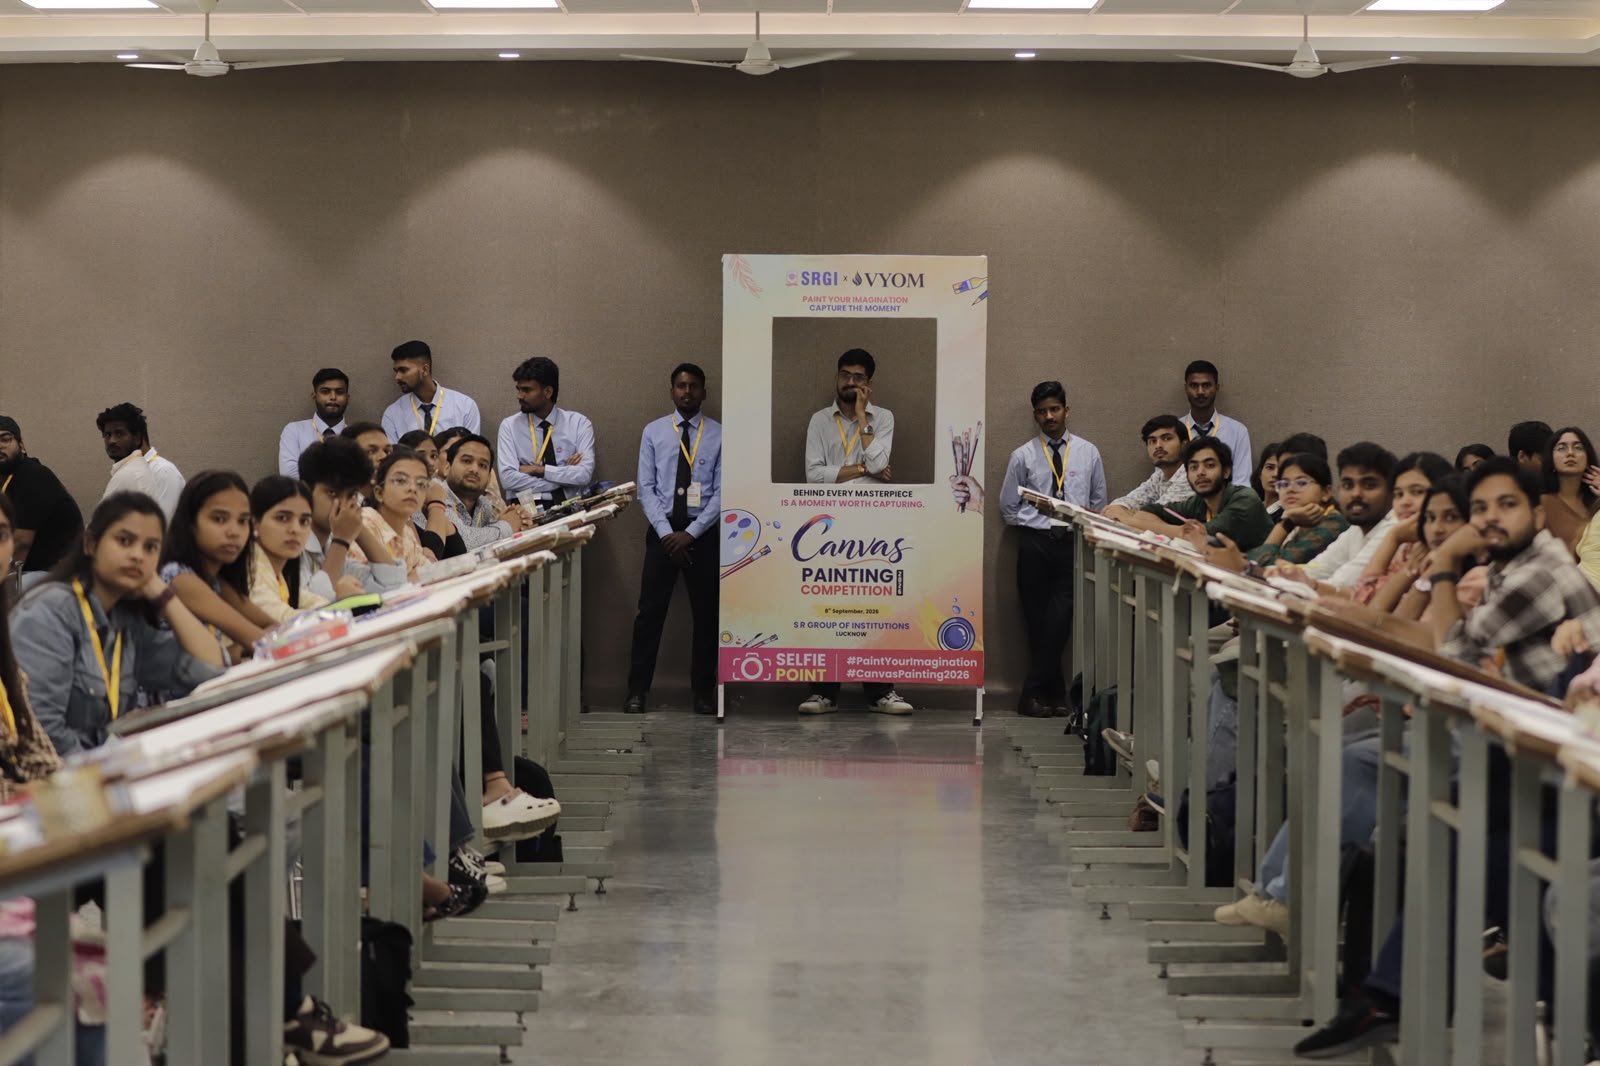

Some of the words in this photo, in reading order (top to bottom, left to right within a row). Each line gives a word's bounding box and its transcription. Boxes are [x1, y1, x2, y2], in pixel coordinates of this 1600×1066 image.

[801, 271, 838, 286] SRGI
[864, 272, 925, 288] VYOM
[802, 295, 827, 303] PAINT
[852, 296, 908, 304] IMAGINATION
[809, 304, 846, 312] CAPTURE
[848, 304, 863, 312] THE
[793, 489, 825, 497] BEHIND
[827, 489, 853, 497] EVERY
[855, 490, 913, 498] MASTERPIECE
[798, 499, 836, 507] MOMENT
[838, 500, 872, 508] WORTH
[873, 500, 925, 509] CAPTURING.
[790, 513, 914, 564] Canvas
[801, 567, 893, 584] PAINTING
[801, 584, 893, 597] COMPETITION
[807, 621, 837, 629] GROUP
[851, 622, 910, 630] INSTITUTIONS
[776, 652, 826, 667] SELFIE
[846, 656, 978, 670] #PaintYourImagination
[775, 668, 827, 682] POINT
[846, 669, 970, 682] #CanvasPainting2026
